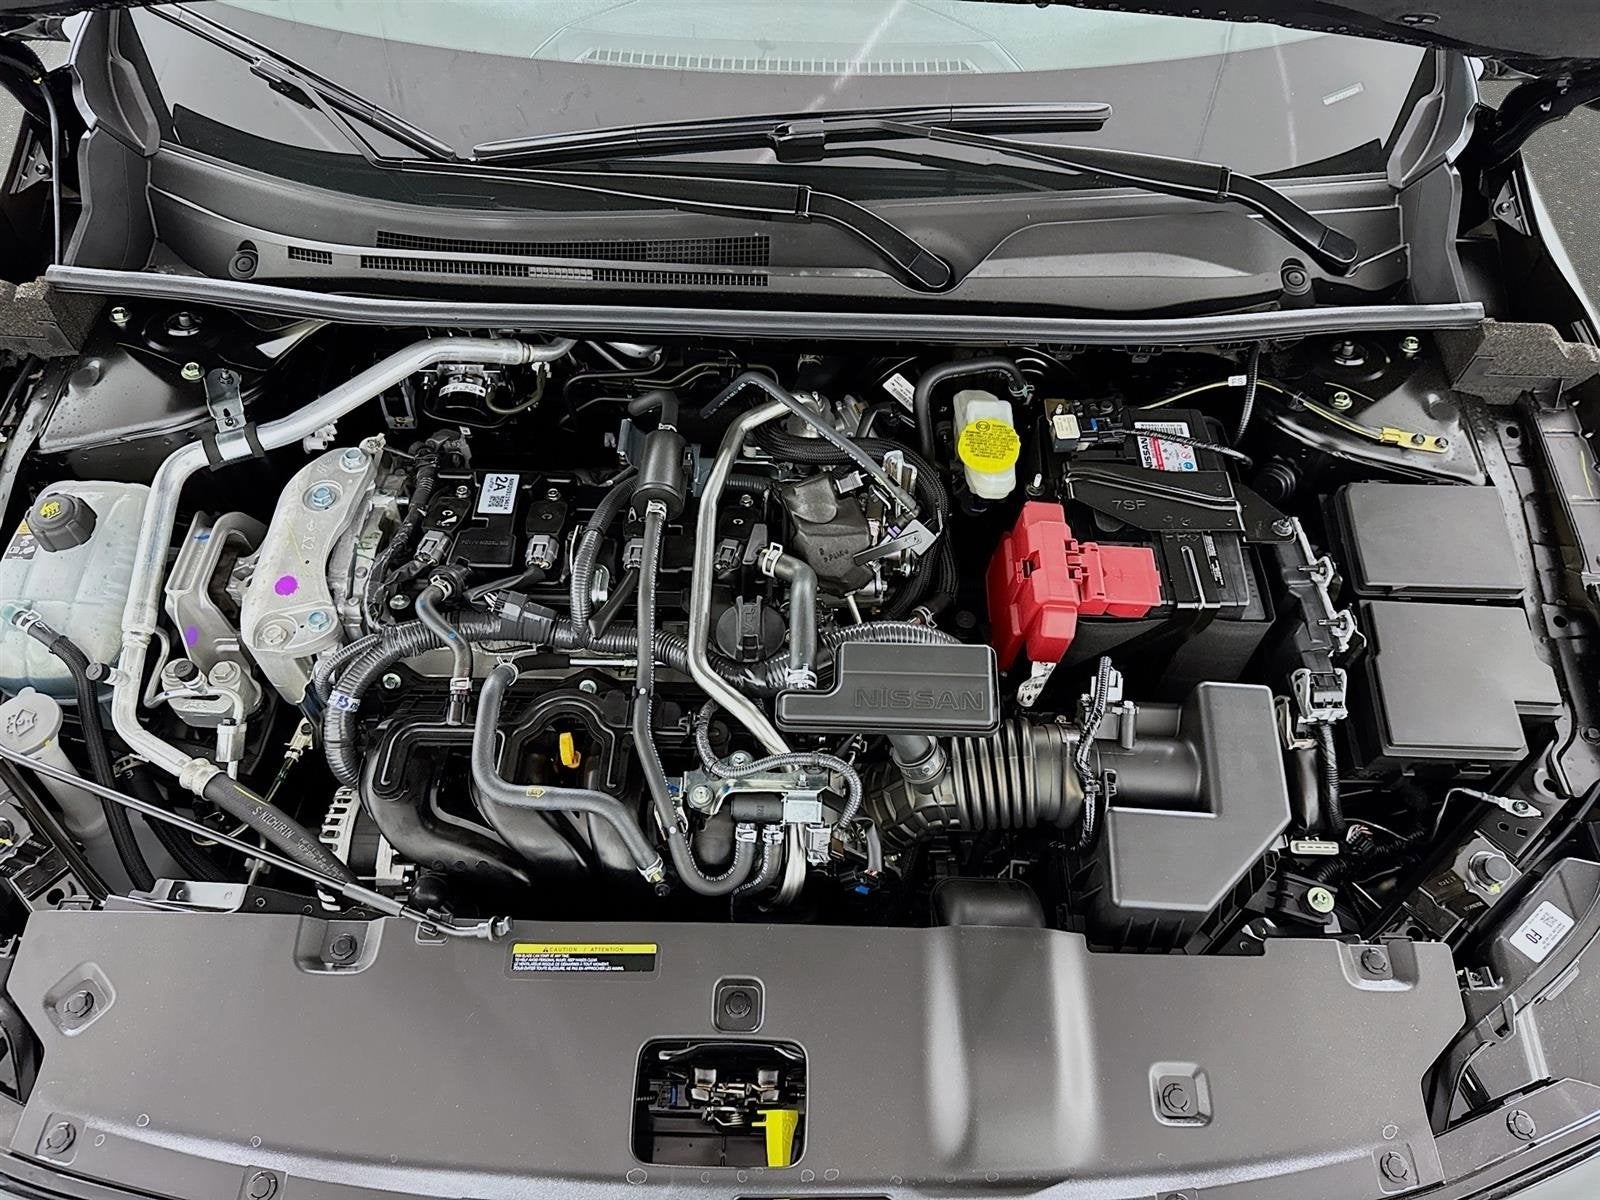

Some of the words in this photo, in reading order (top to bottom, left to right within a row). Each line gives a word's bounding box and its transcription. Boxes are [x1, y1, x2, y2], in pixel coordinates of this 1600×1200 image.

[493, 476, 509, 491] 2A
[1111, 499, 1147, 510] 7SF
[854, 688, 984, 711] NISSAN
